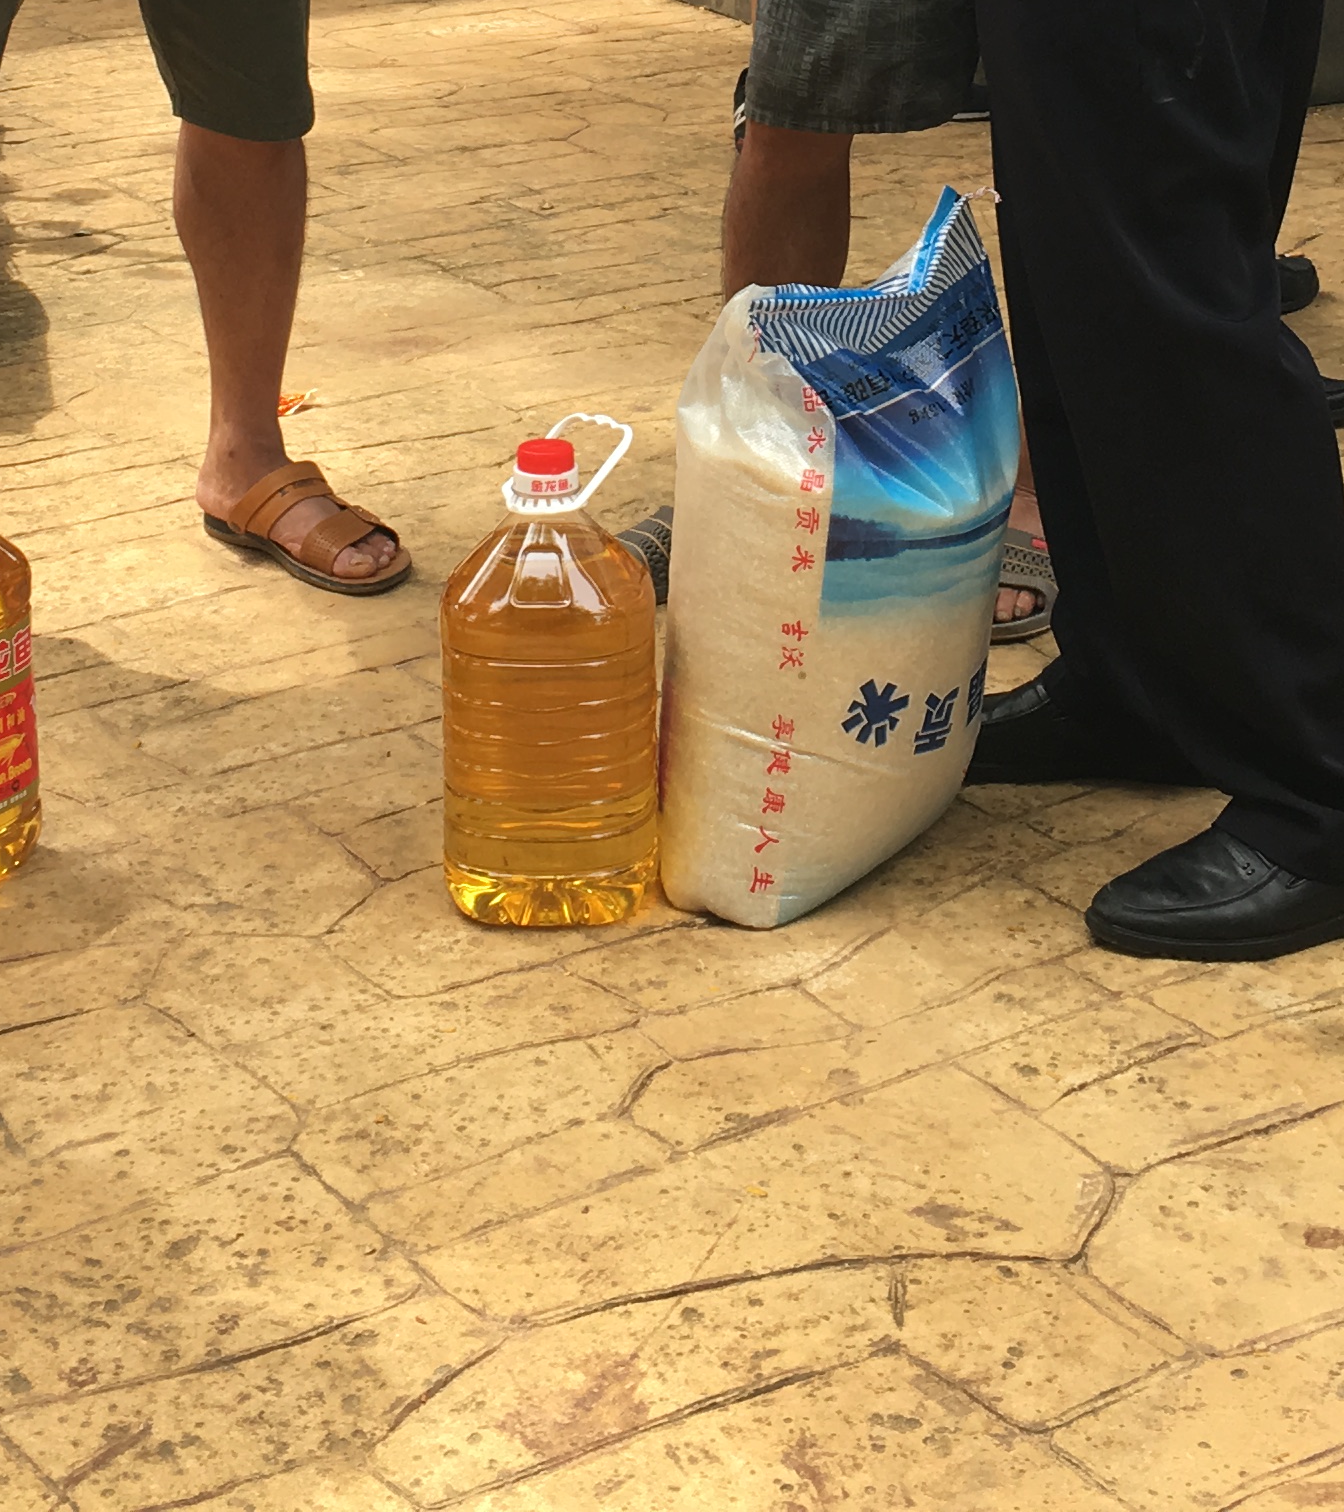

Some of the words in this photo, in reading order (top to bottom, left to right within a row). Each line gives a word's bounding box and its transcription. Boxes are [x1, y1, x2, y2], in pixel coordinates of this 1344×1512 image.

[531, 478, 568, 493] 金龙鱼
[777, 619, 809, 672] 吉沃
[749, 713, 796, 897] 享健康人生
